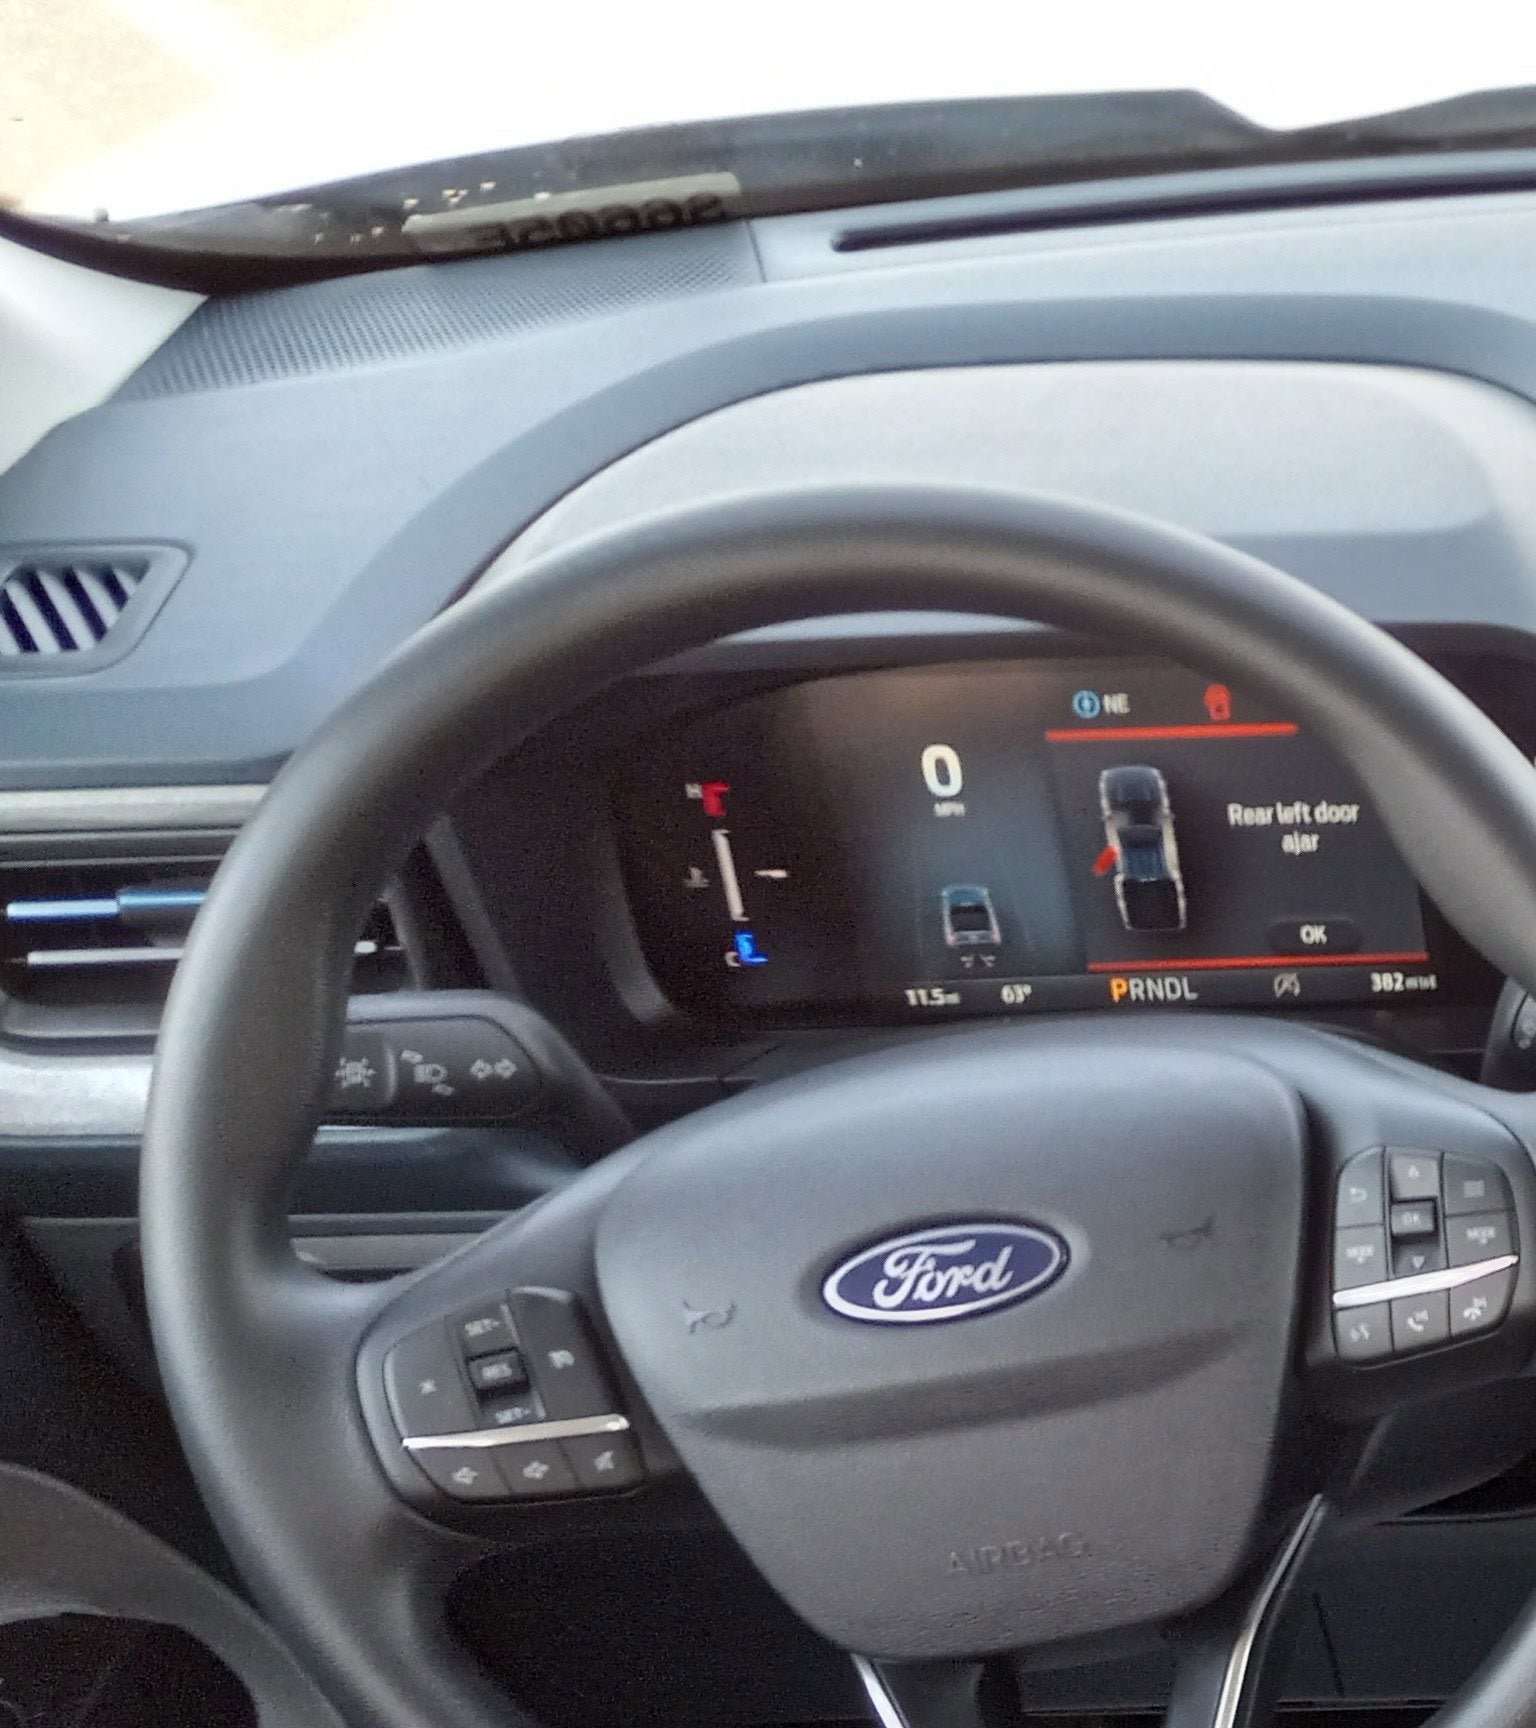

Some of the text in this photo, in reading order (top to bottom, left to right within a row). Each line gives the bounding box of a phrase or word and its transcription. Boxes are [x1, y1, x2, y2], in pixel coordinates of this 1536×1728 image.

[921, 743, 964, 799] 0
[1228, 801, 1360, 826] Rear left door
[1282, 831, 1320, 855] ajar
[1300, 924, 1327, 945] OK
[872, 1239, 1015, 1309] Ford
